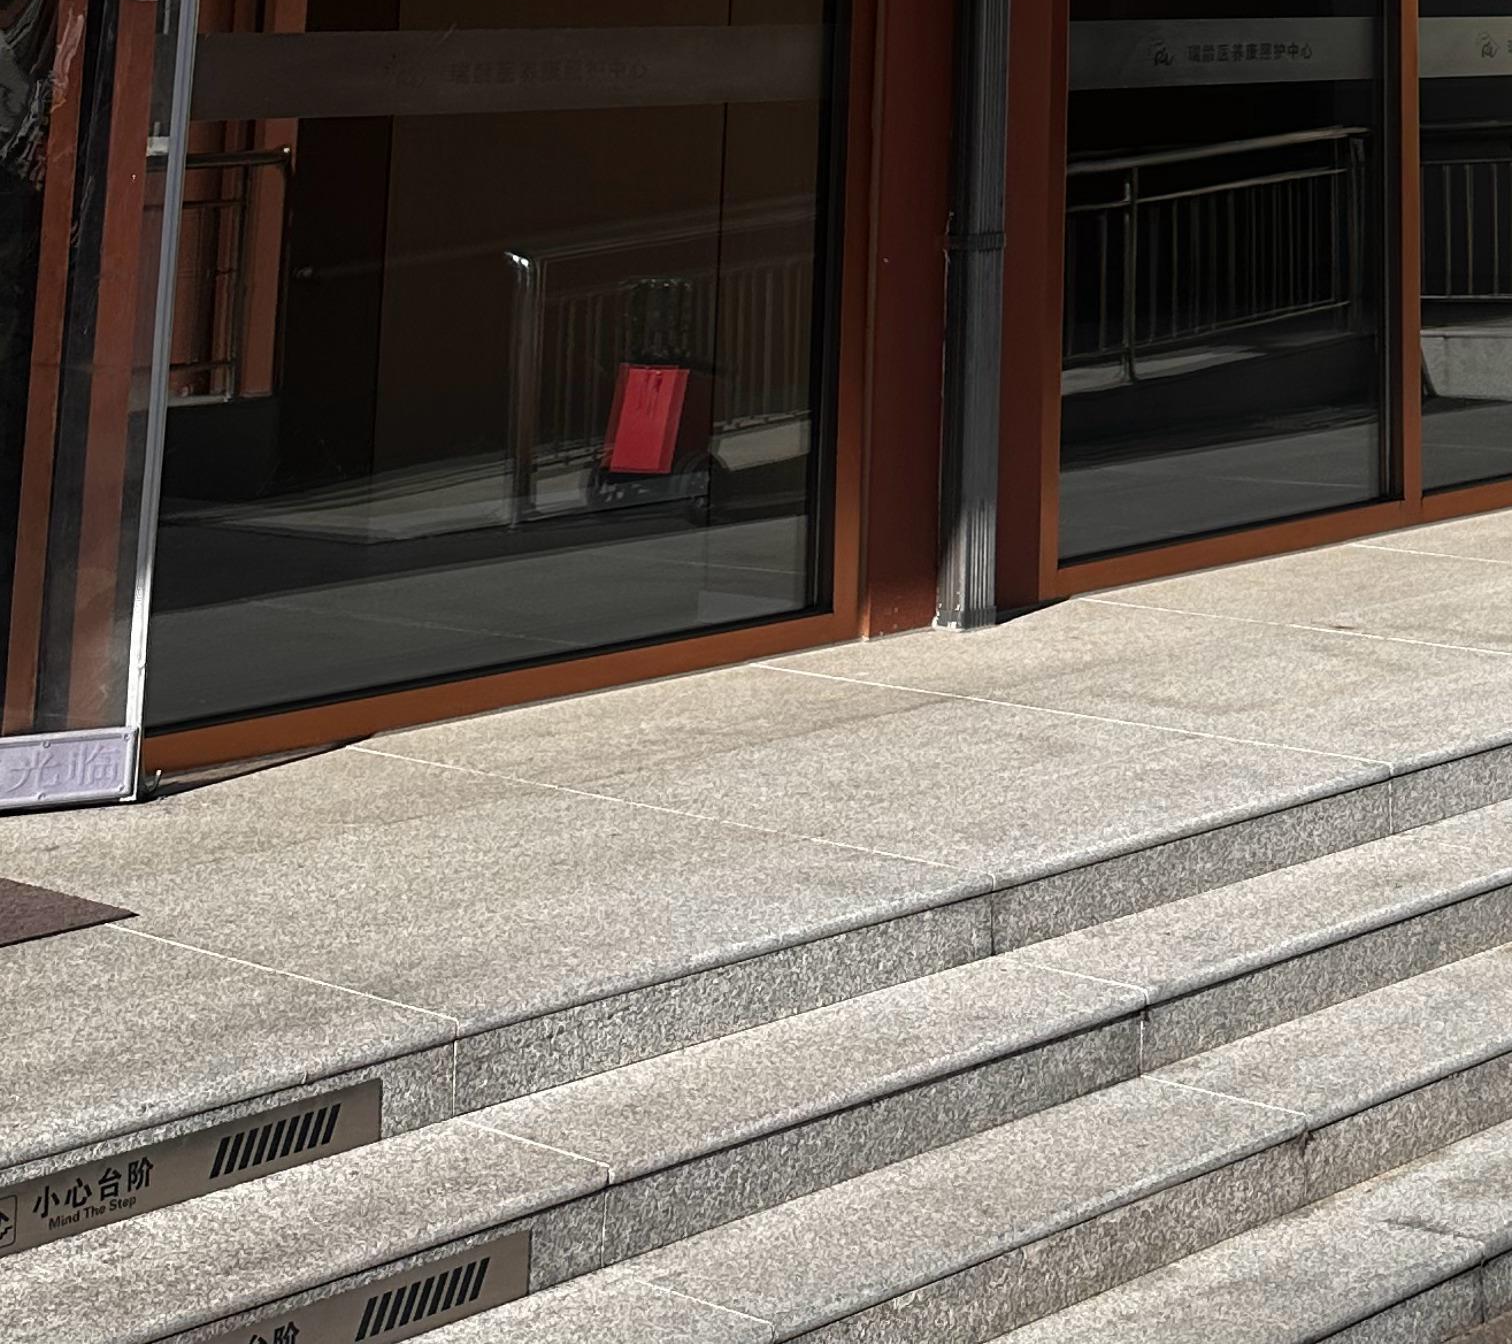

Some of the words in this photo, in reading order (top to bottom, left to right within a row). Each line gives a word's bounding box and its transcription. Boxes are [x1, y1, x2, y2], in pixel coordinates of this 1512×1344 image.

[6, 742, 121, 793] 光临
[33, 1156, 154, 1218] 小心台阶
[49, 1212, 80, 1230] Mind
[84, 1206, 105, 1220] The
[109, 1196, 137, 1211] Step
[250, 1321, 299, 1344] 阶
